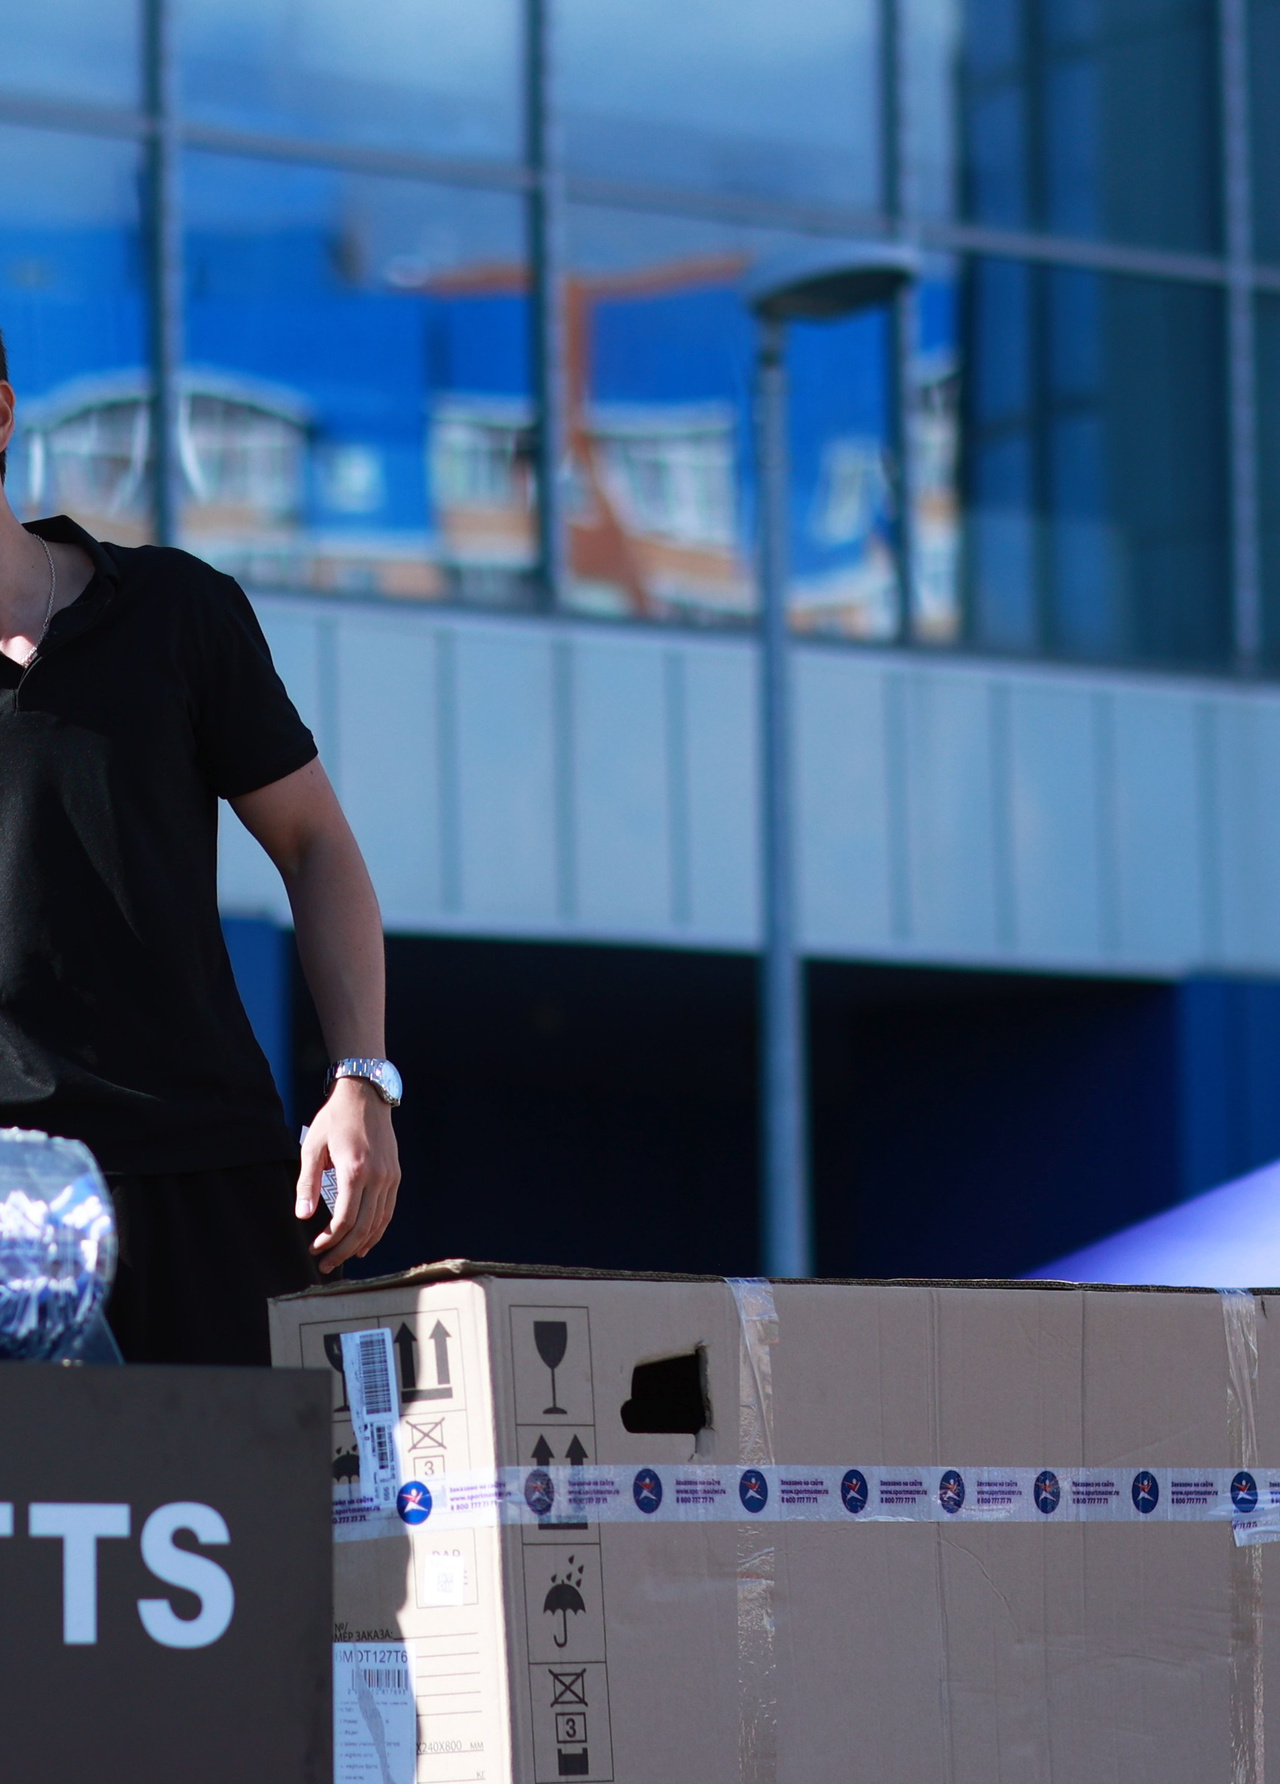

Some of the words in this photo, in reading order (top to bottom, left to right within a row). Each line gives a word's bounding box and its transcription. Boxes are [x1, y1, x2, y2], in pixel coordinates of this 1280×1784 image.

[424, 1460, 435, 1476] 3
[332, 1504, 380, 1515] .sportmaster.ru
[332, 1631, 355, 1642] МЕР
[356, 1629, 393, 1641] ЗАКАЗА:
[565, 1717, 577, 1738] 3
